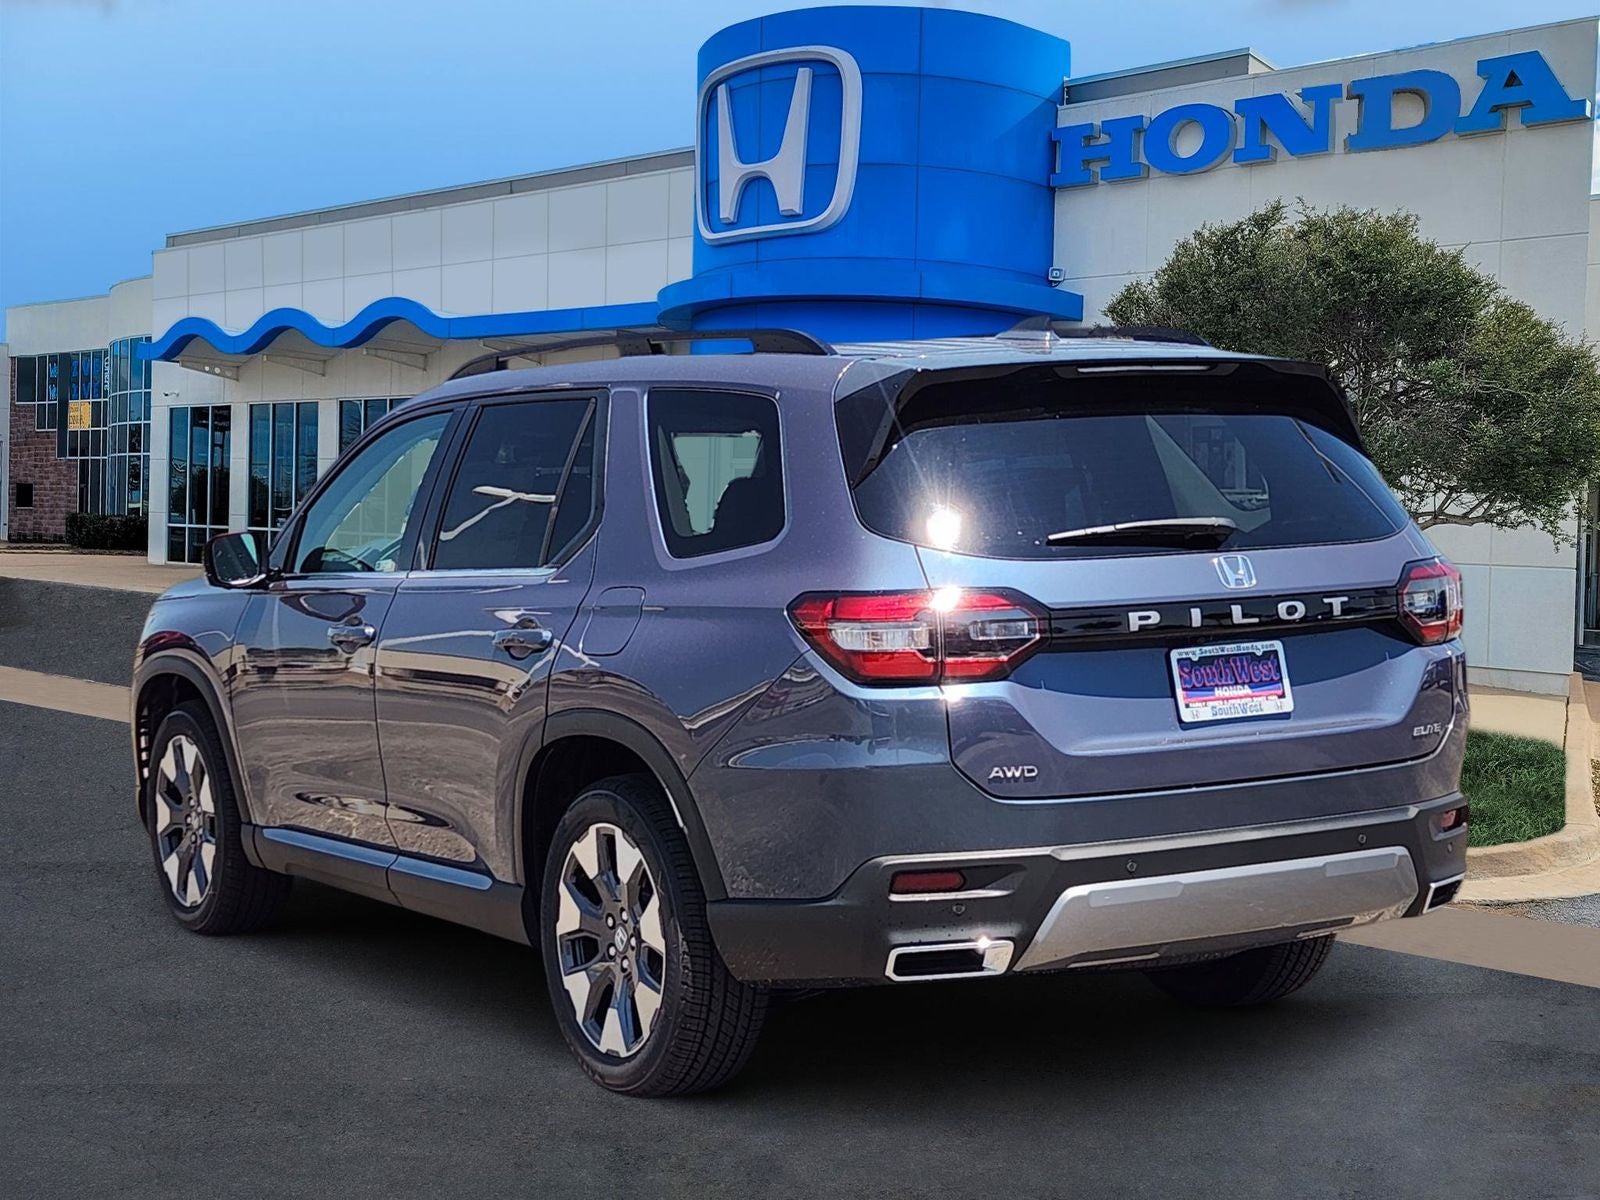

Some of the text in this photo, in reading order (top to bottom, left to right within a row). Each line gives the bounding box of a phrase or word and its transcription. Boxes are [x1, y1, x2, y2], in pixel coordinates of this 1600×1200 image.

[1051, 50, 1591, 188] HONDA
[1127, 596, 1349, 632] PILOT
[1178, 654, 1281, 688] SouthWest
[1214, 685, 1252, 697] HONDA
[1211, 702, 1264, 716] SouthWest
[1413, 722, 1442, 737] ELITE
[988, 765, 1038, 779] AWD
